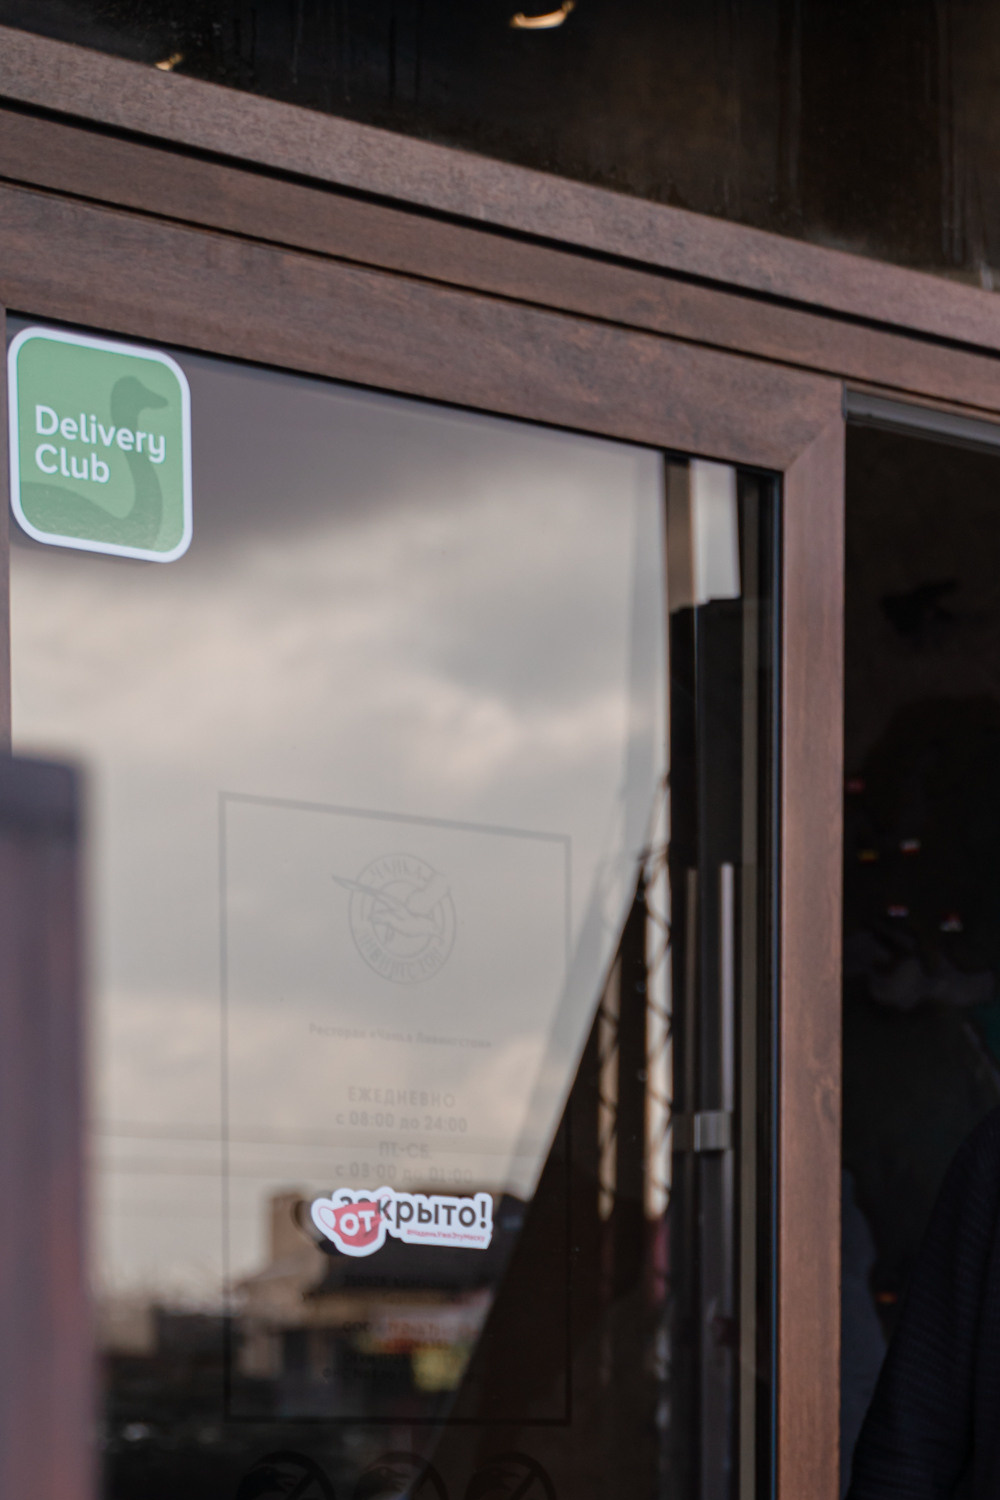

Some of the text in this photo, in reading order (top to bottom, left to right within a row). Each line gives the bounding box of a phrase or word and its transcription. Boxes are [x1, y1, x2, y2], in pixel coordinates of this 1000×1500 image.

[36, 405, 166, 464] Delivery
[35, 443, 111, 484] Club
[347, 1086, 456, 1108] ЕЖЕДНЕВНО
[349, 1111, 395, 1128] 08:00
[399, 1117, 421, 1131] до
[424, 1115, 468, 1133] 24:00
